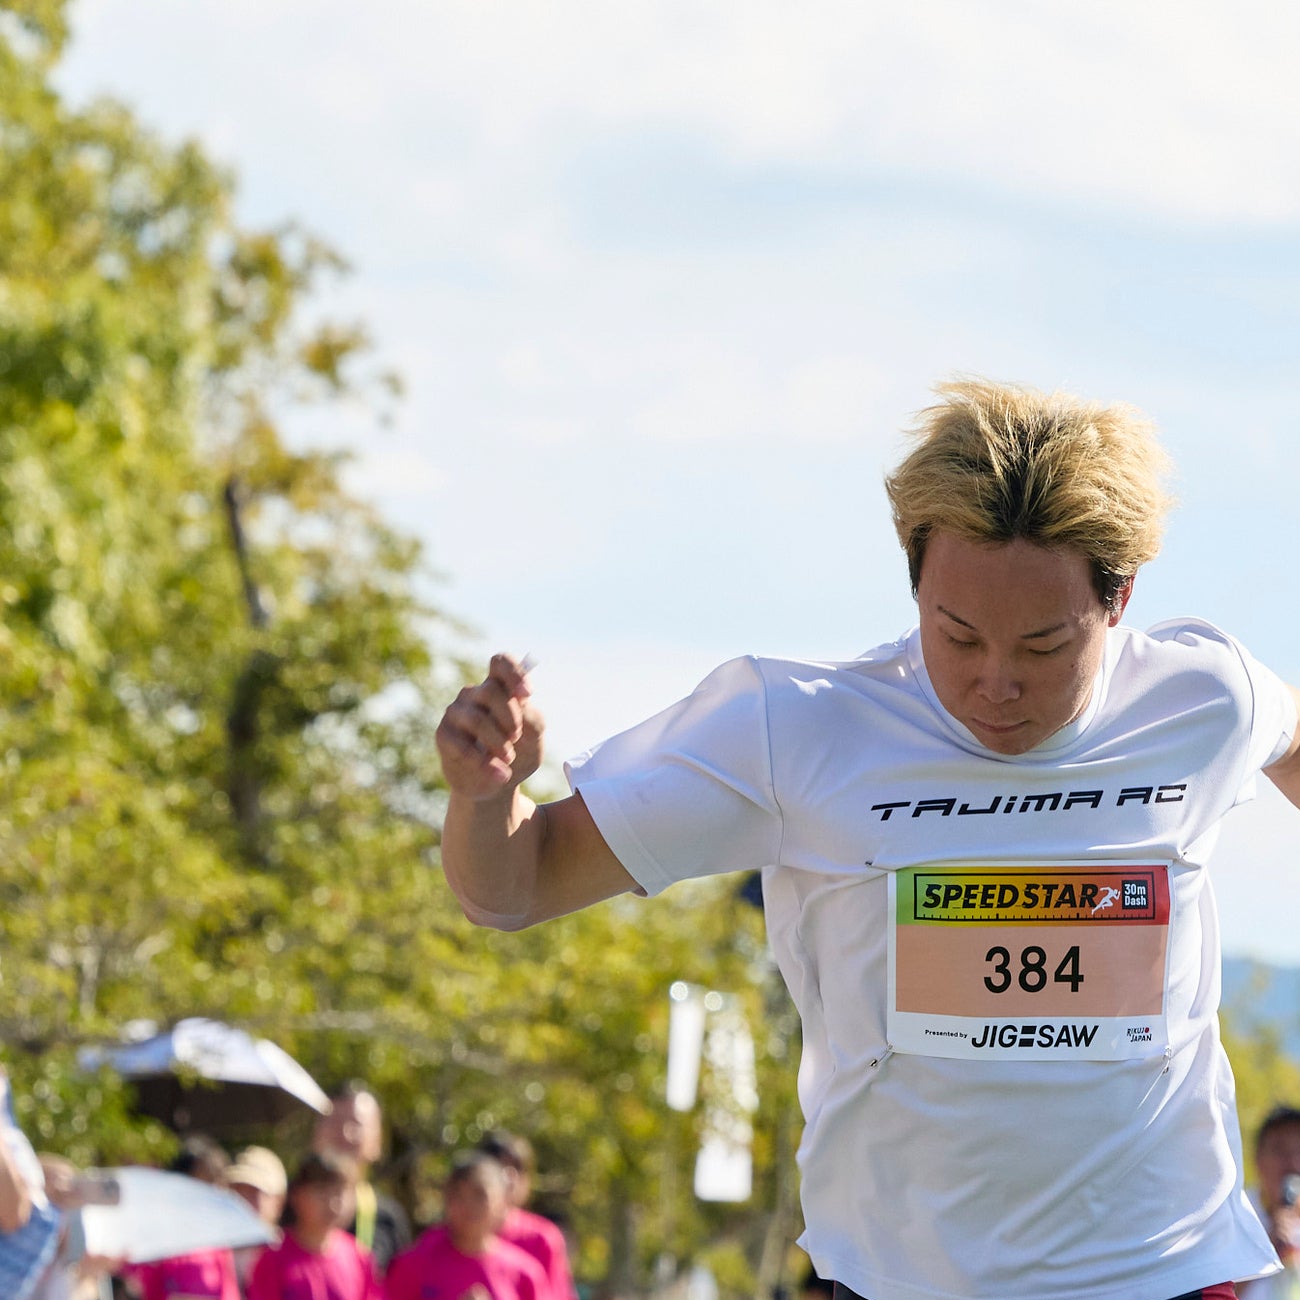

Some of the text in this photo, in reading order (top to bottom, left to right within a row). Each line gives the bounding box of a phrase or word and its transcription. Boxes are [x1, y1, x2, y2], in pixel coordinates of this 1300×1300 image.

[871, 783, 1187, 821] TAJIMA AC
[1124, 883, 1147, 895] 30m
[1124, 895, 1147, 907] Dash
[983, 945, 1085, 994] 384
[924, 1029, 958, 1038] Presented
[959, 1031, 968, 1039] by
[1130, 1033, 1152, 1043] JAPAN
